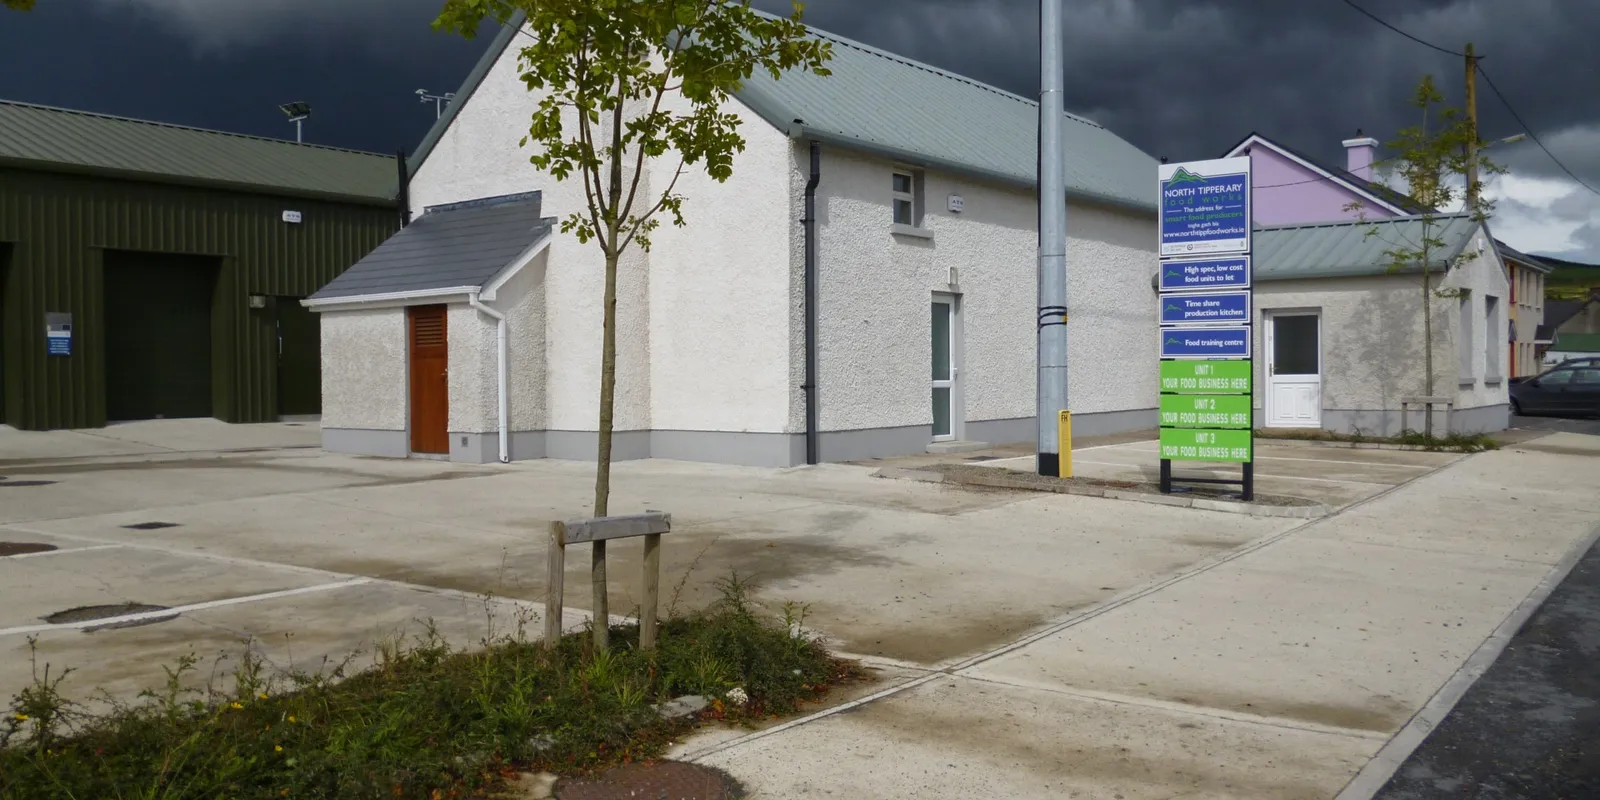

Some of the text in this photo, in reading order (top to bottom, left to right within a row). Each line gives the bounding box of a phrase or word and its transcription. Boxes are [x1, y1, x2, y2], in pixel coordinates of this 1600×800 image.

[1165, 184, 1242, 197] NORTH TIPPERARY
[1165, 194, 1242, 206] food works
[1207, 211, 1243, 220] producers
[1164, 227, 1244, 238] www.northtippfoodworks.ie
[1184, 266, 1199, 274] High
[1185, 310, 1218, 318] production
[1201, 339, 1223, 347] training
[1195, 365, 1213, 375] UNIT 1
[1163, 378, 1247, 389] YOUR FOOD BUSINESS HERE
[1194, 399, 1215, 410] UNIT 2
[1162, 412, 1247, 424] YOUR FOOD BUSINESS HERE
[1196, 433, 1215, 444] UNIT 3
[1163, 446, 1247, 458] YOUR FOOD BUSINESS HERE
